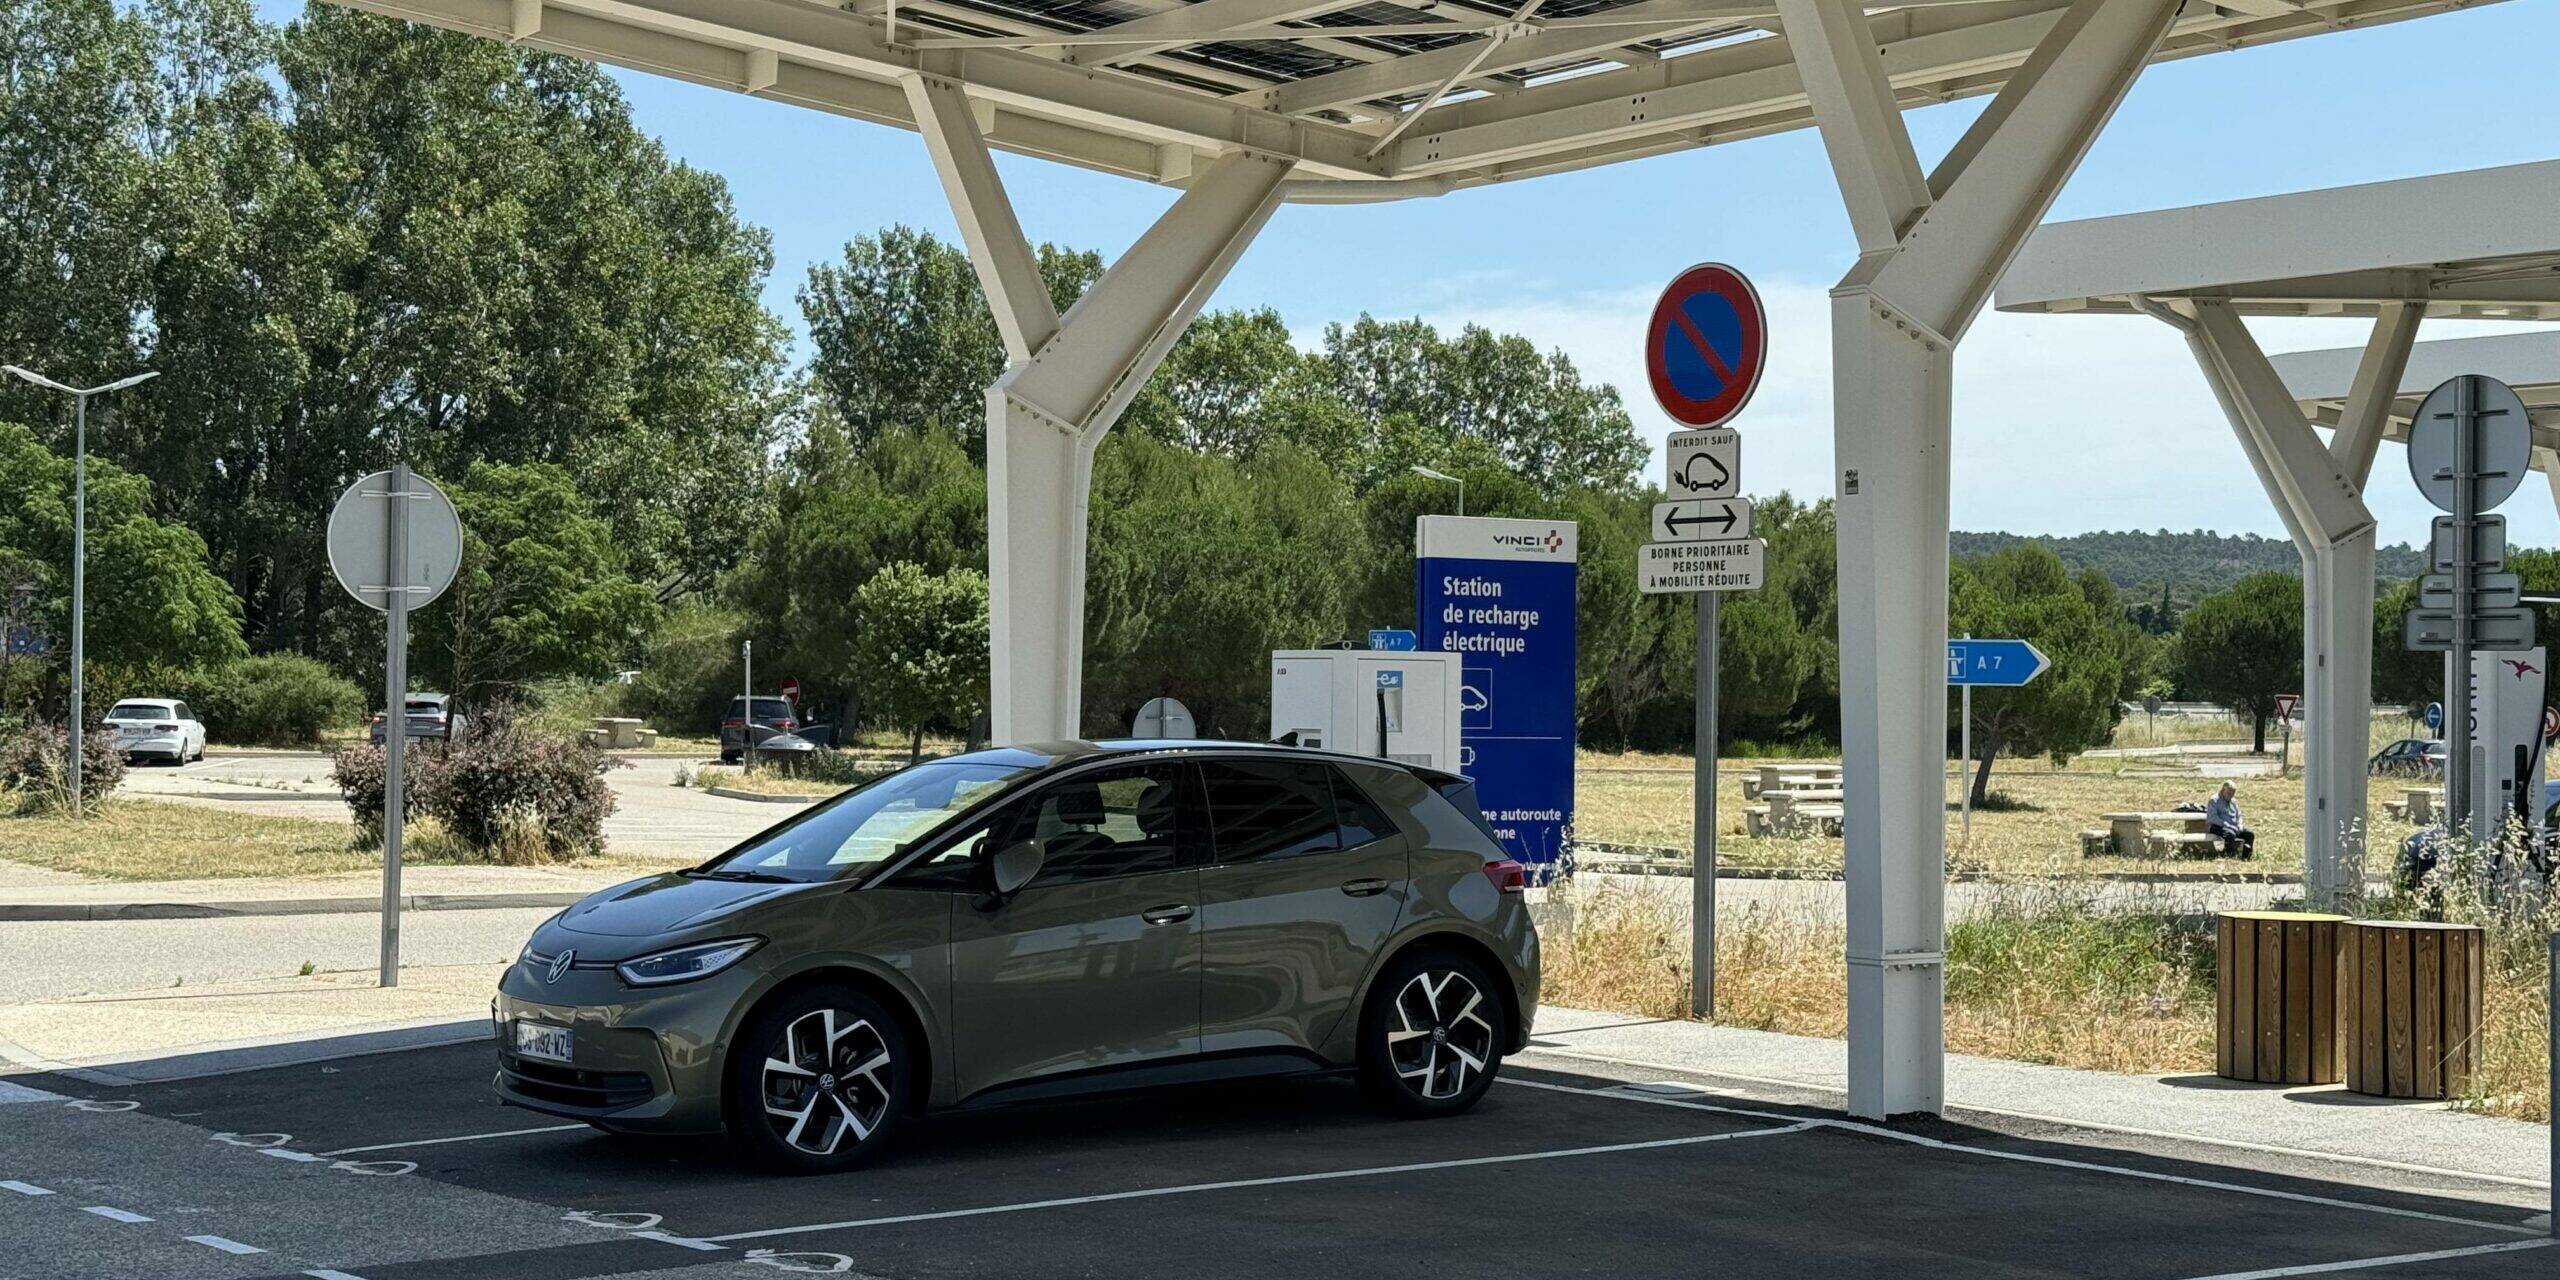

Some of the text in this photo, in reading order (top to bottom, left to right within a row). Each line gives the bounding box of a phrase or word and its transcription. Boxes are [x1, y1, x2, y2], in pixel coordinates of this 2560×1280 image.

[1670, 434, 1734, 449] INTERDIT SAUF
[1493, 535, 1540, 546] VINCI
[1651, 544, 1750, 559] BORNE PRIORITAIRE
[1673, 560, 1726, 573] PERSONNE
[1443, 576, 1502, 597] Station
[1650, 571, 1751, 588] À MOBILITÉ RÉDUITE
[1443, 603, 1539, 631] de recharge
[1442, 631, 1525, 657] électrique
[1977, 656, 2003, 670] A 7
[1481, 808, 1562, 821] ne autoroute
[1493, 828, 1516, 839] one
